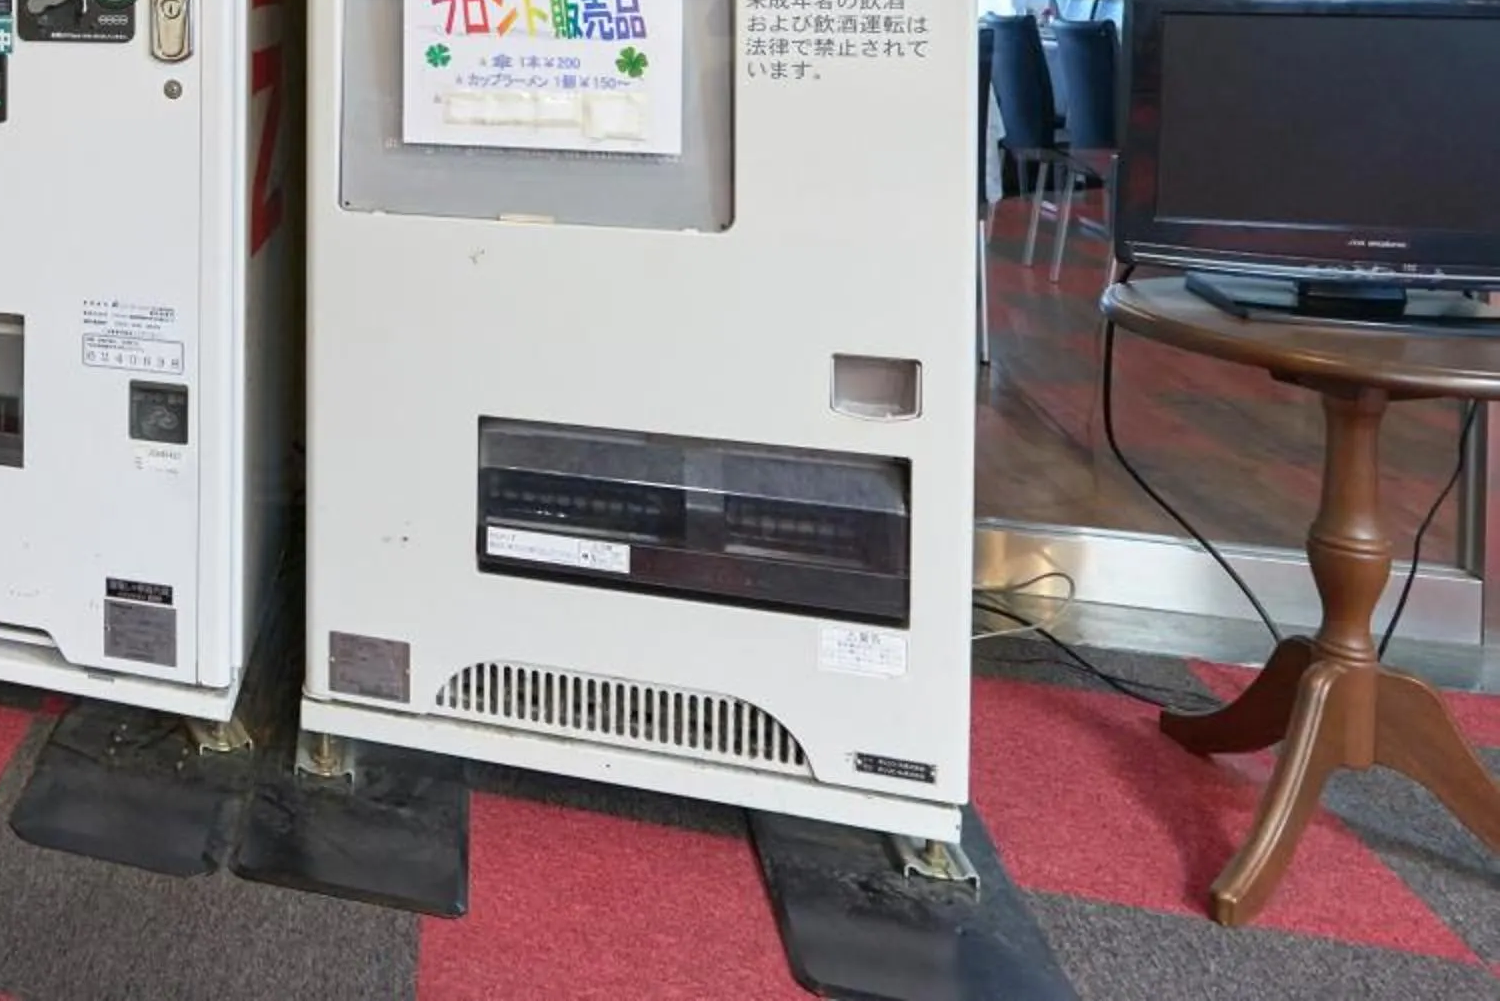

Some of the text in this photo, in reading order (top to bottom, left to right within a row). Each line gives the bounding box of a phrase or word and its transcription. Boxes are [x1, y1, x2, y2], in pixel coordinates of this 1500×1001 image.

[746, 14, 930, 34] および飲酒運転は
[745, 37, 930, 58] 法律で禁止されて
[491, 53, 513, 69] 傘
[746, 60, 822, 80] います。
[467, 73, 549, 89] カップラーメン
